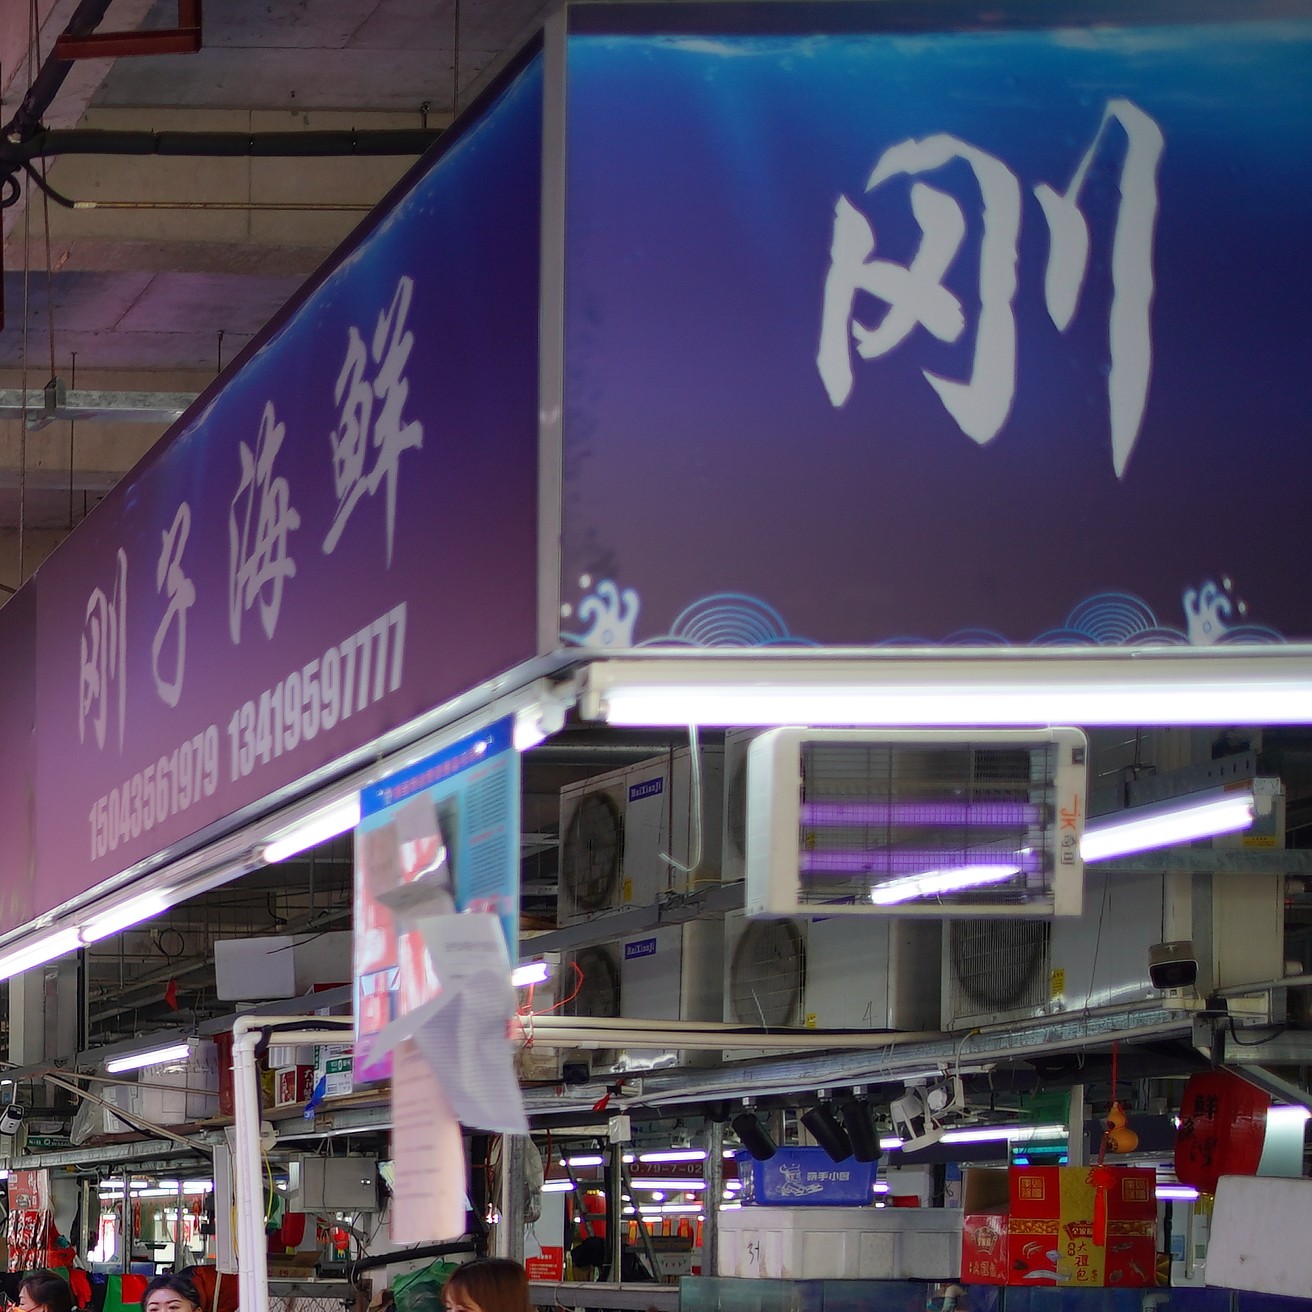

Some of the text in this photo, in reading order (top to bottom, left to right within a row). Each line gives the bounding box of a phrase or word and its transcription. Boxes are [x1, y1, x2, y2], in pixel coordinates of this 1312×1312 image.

[816, 97, 1166, 480] 刚
[88, 601, 406, 861] 15043561979 13419597777
